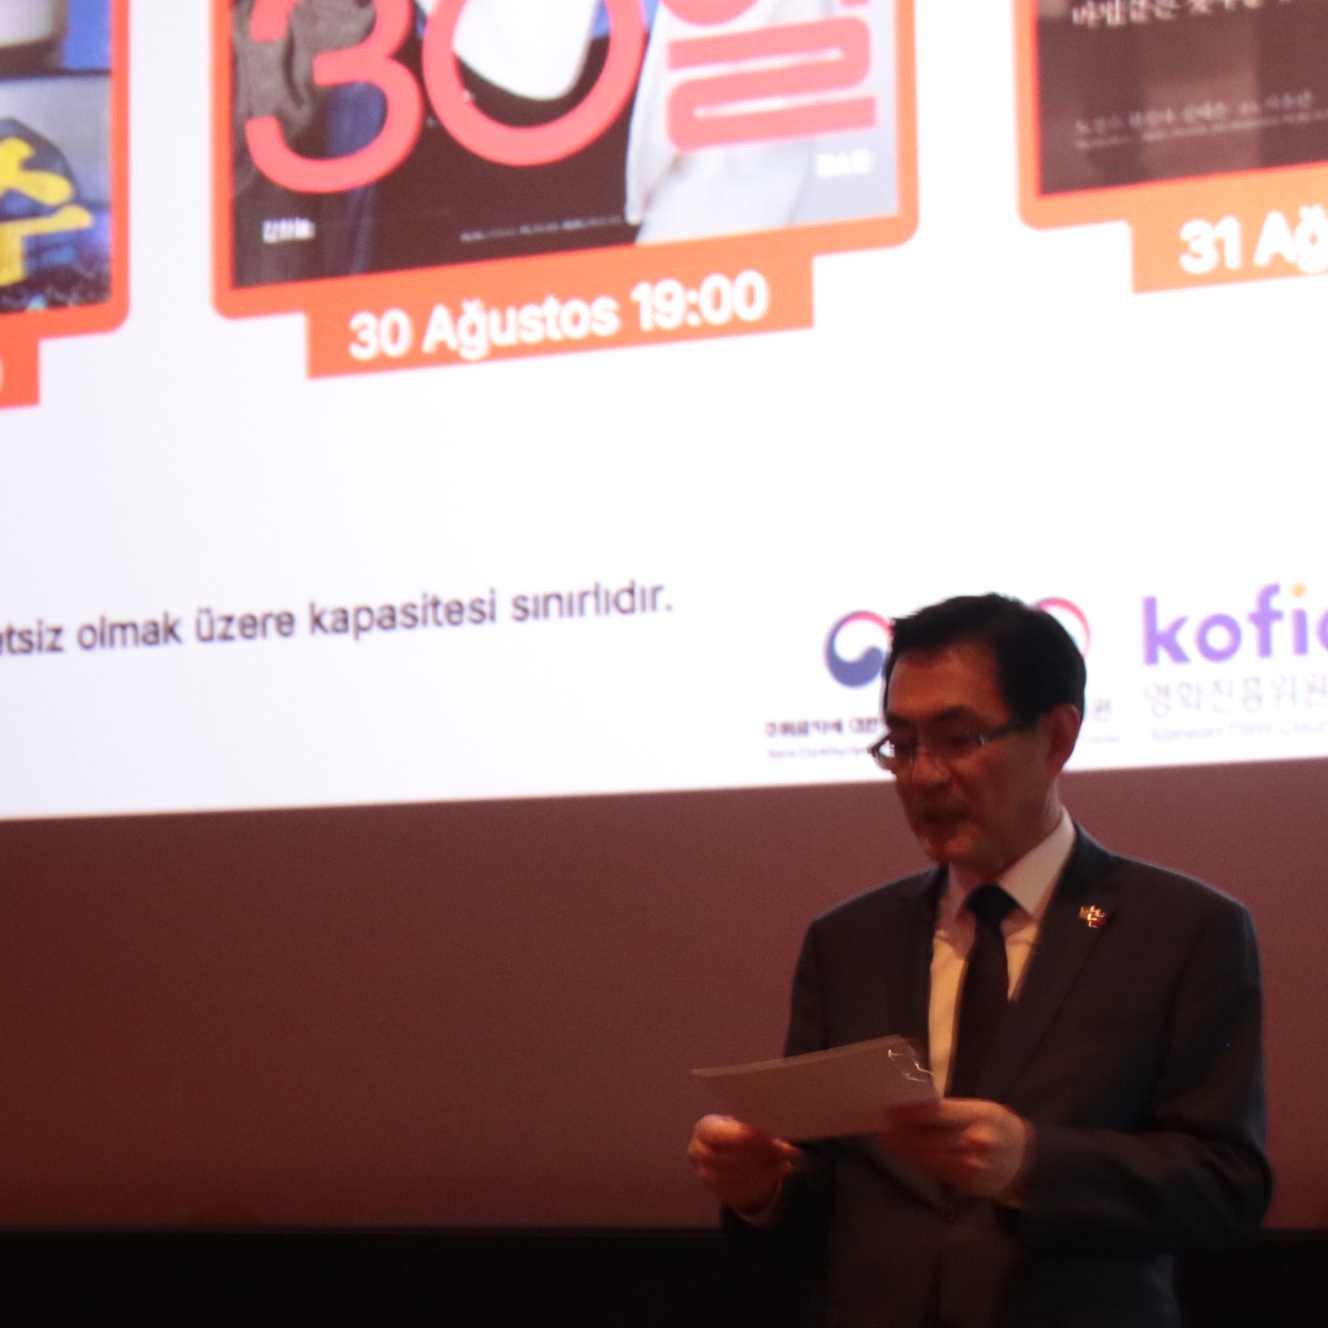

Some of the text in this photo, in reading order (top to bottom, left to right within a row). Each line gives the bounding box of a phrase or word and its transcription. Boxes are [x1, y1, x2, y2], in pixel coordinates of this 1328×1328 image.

[1179, 214, 1243, 275] 31
[348, 268, 768, 362] 30 Ağustos 19:00
[75, 611, 184, 652] olmak
[194, 606, 297, 645] üzere
[307, 587, 498, 643] kapasitesi
[510, 578, 674, 624] sınırlıdır.
